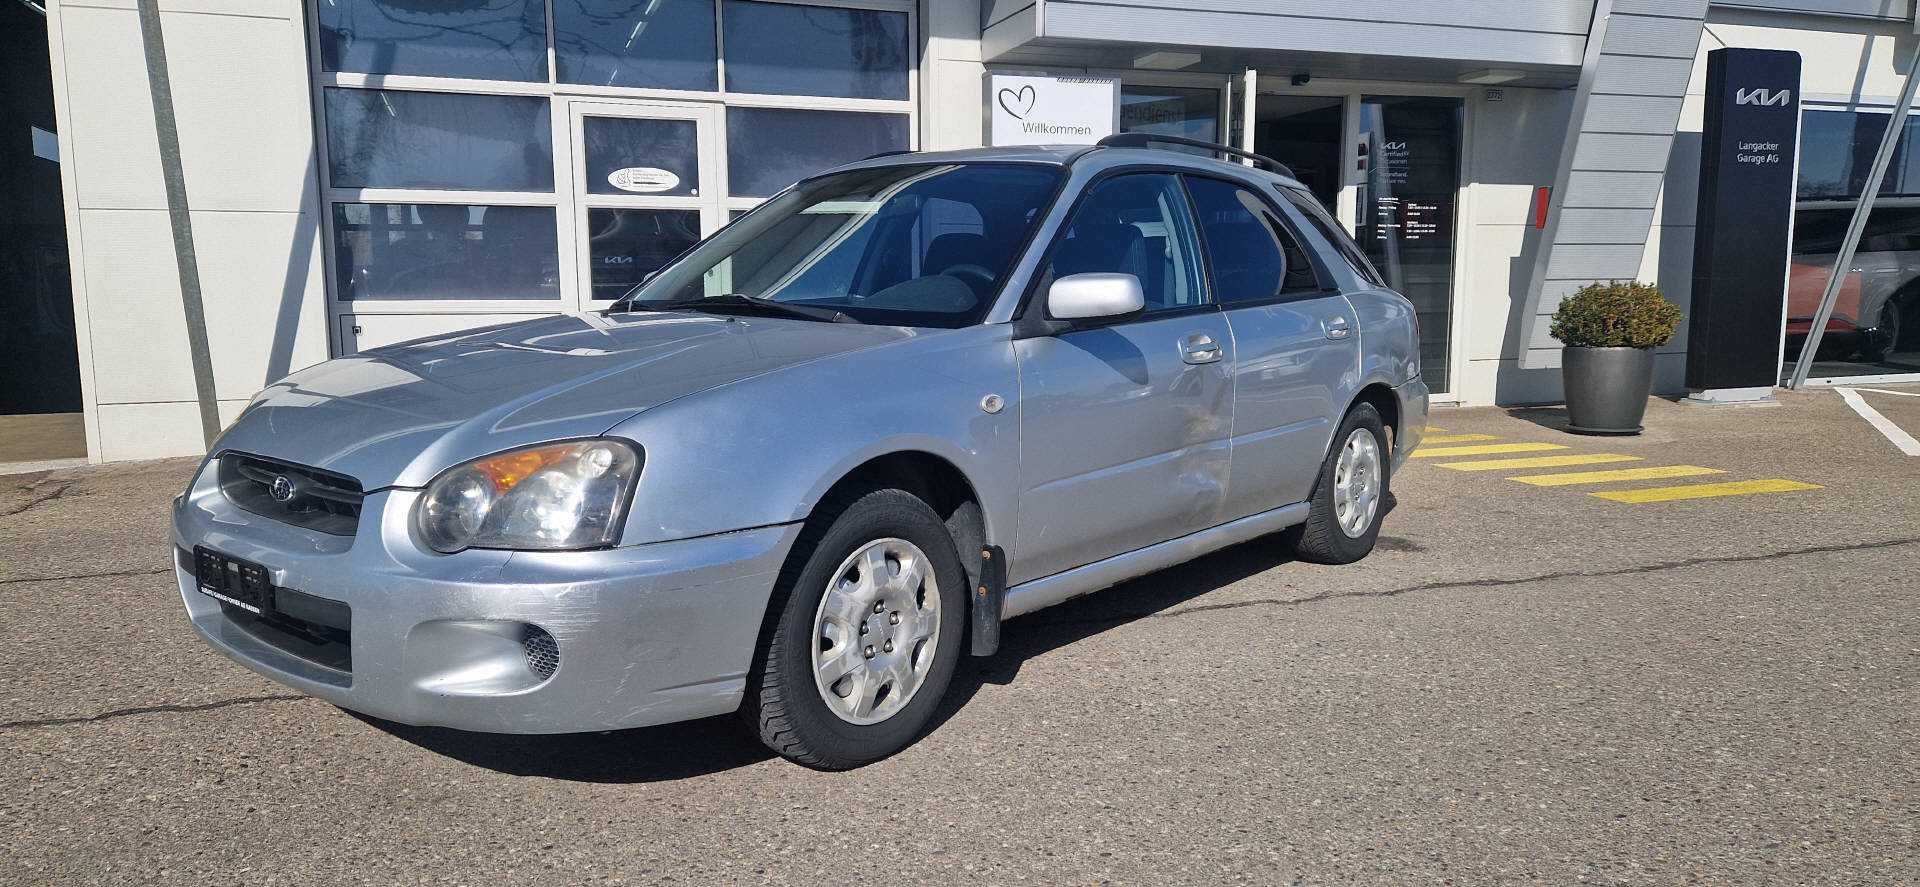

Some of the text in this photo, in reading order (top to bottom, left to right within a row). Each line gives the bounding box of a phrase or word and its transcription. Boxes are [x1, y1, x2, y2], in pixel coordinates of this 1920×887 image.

[1736, 88, 1790, 106] KIA
[1022, 121, 1091, 135] Willkommen
[1738, 141, 1779, 152] Langacker
[1737, 153, 1779, 165] Garage AG
